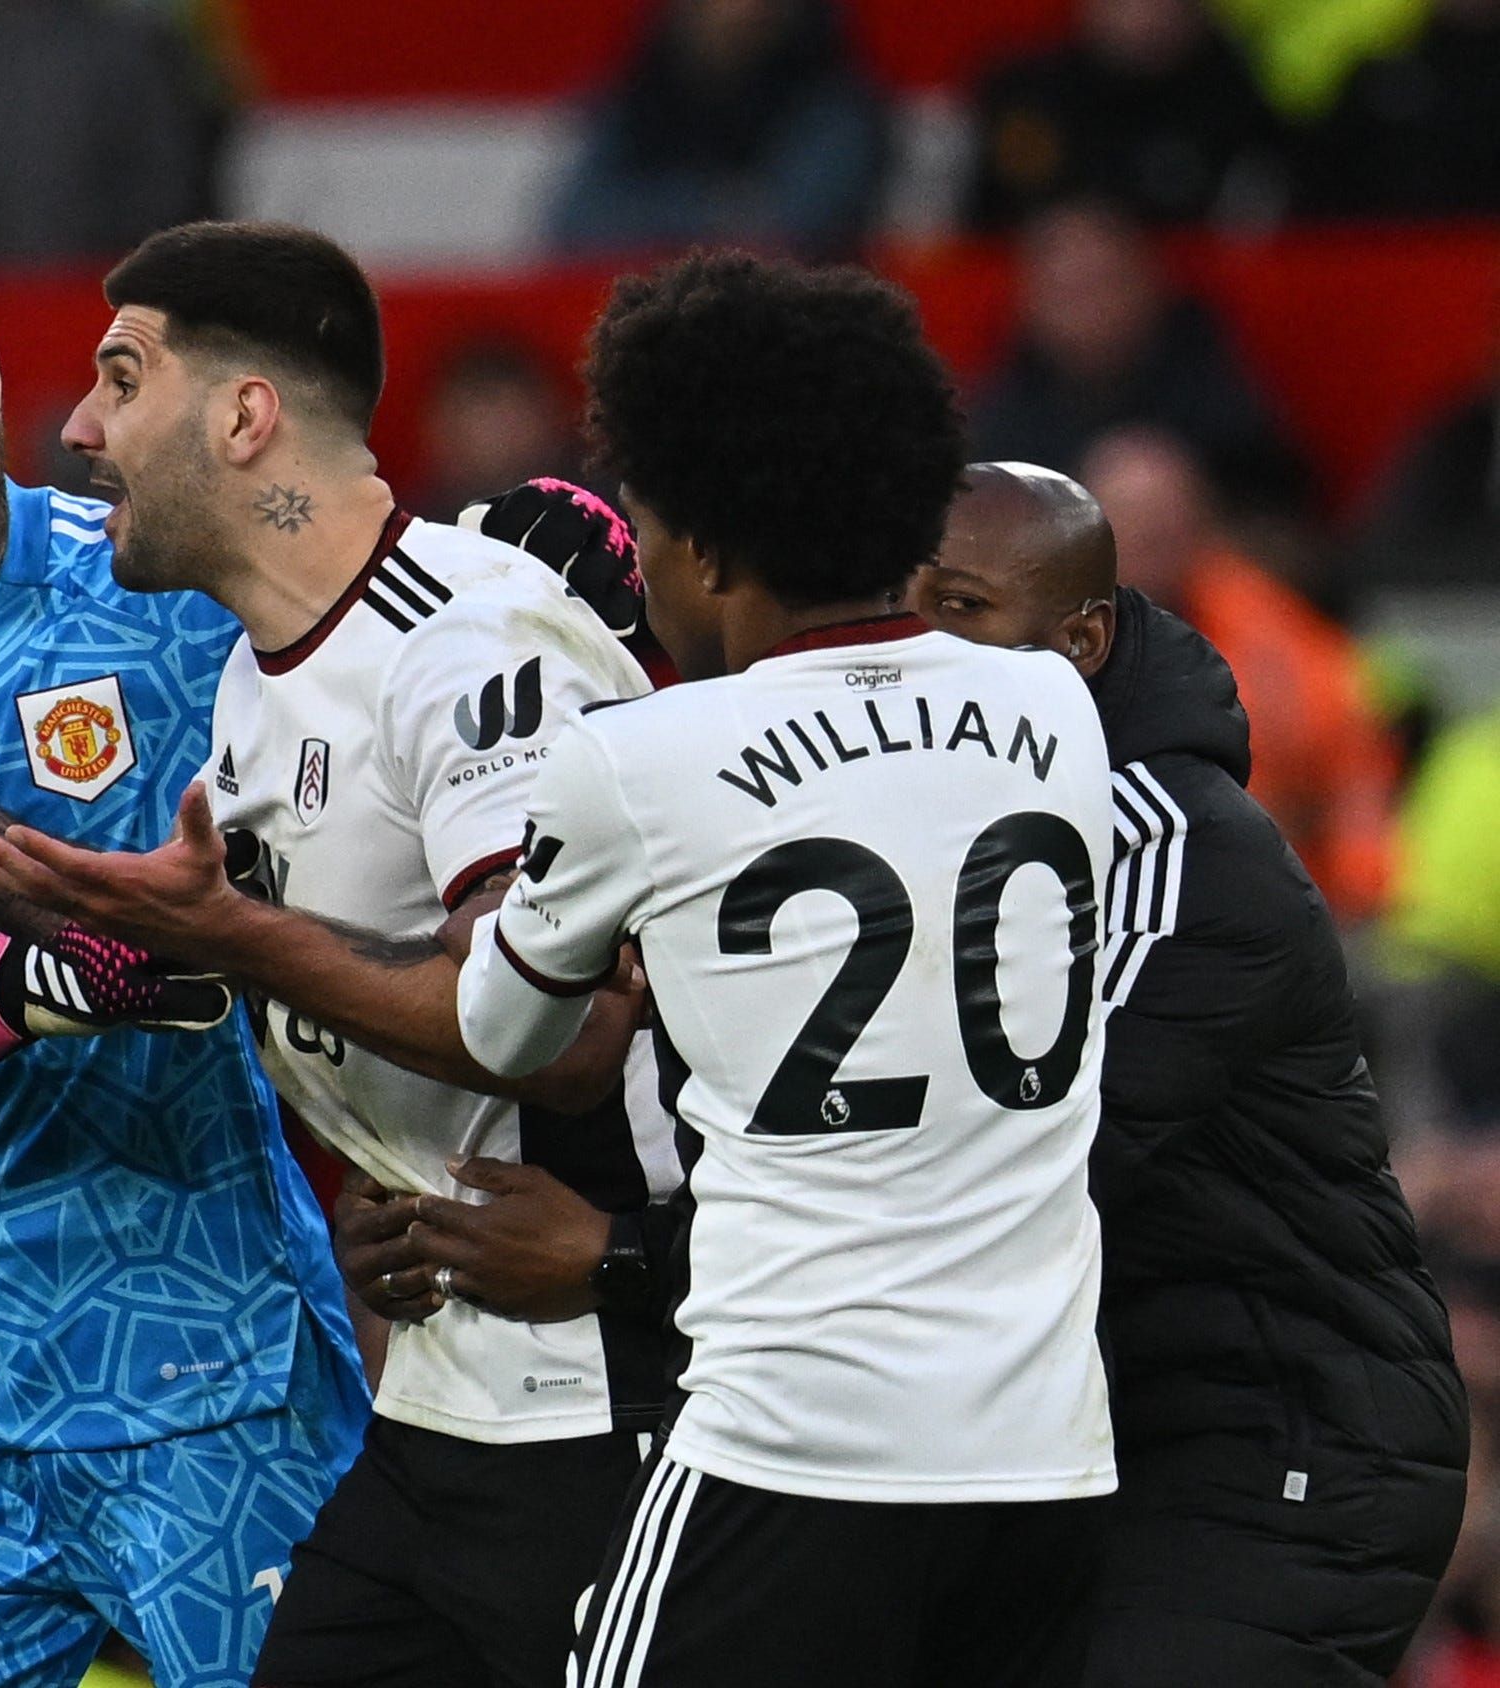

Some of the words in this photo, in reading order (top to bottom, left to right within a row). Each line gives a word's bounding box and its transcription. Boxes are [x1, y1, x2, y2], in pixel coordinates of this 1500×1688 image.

[845, 668, 902, 689] Original
[40, 702, 107, 737] MANCHESTER
[60, 757, 108, 777] UNITED
[716, 697, 1058, 808] WILLIAN
[447, 755, 515, 788] WORLD
[717, 810, 1099, 1136] 20
